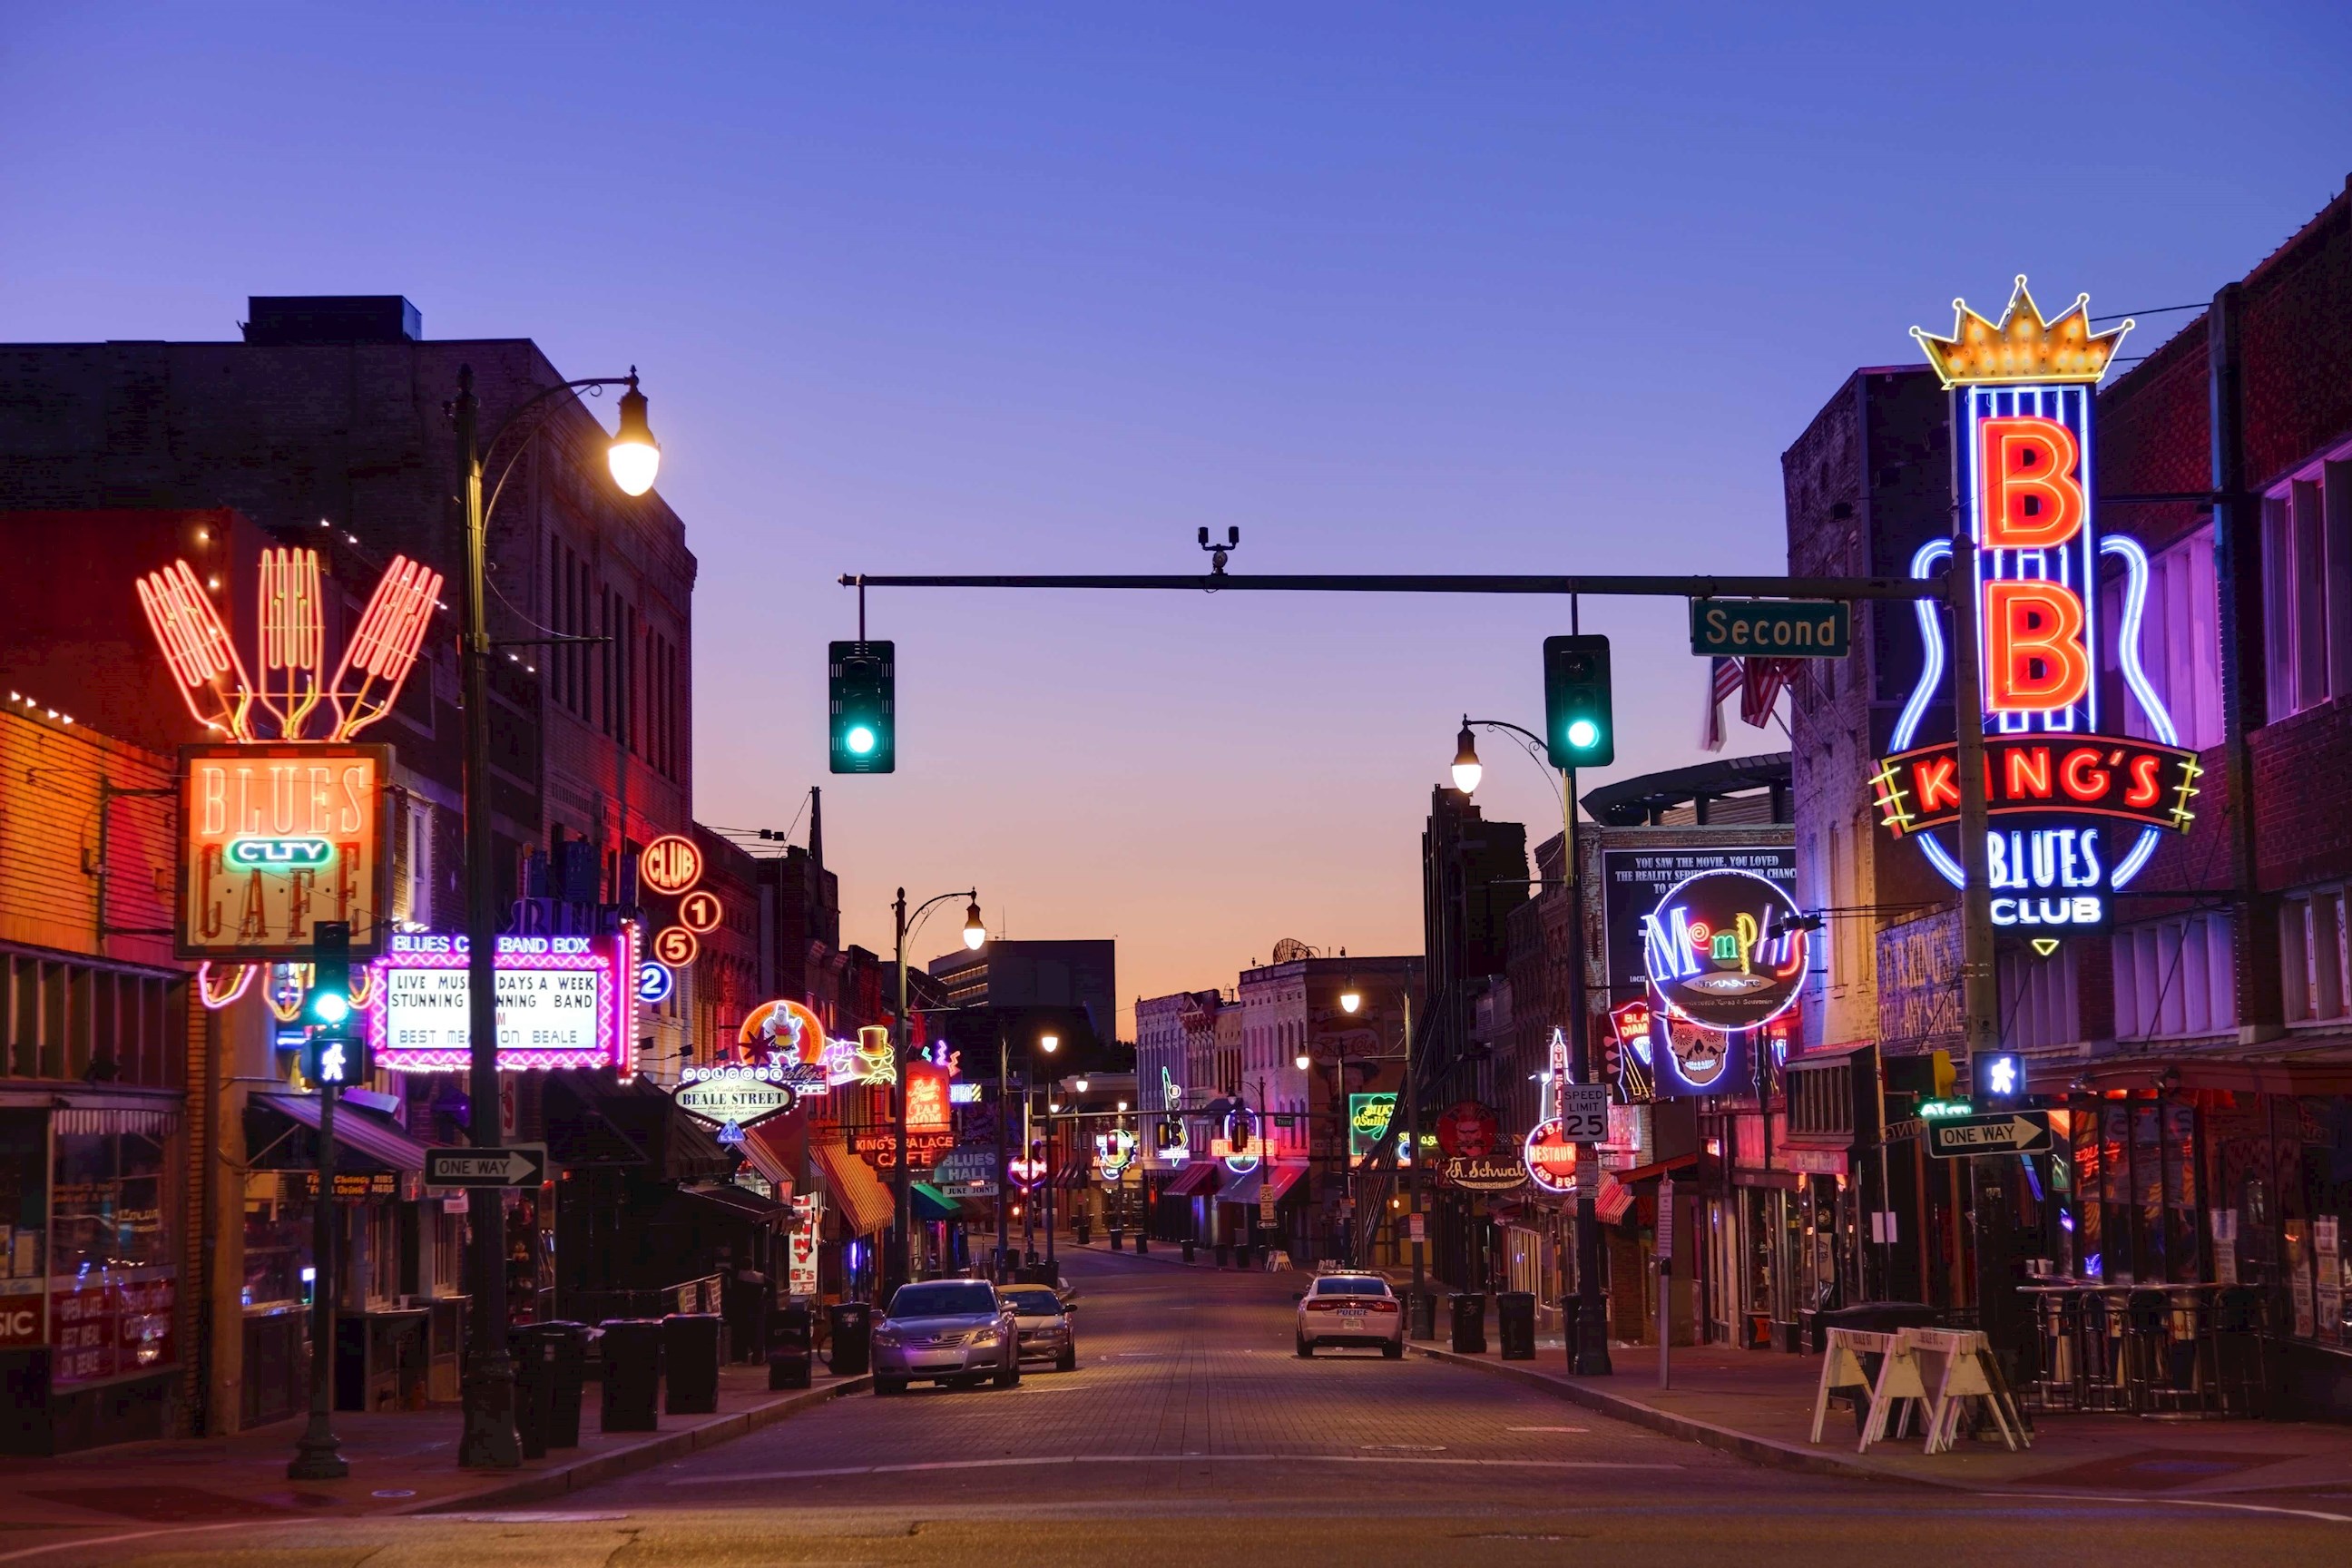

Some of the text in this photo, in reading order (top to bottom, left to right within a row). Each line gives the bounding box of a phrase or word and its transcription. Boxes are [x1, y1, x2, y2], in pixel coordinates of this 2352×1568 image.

[1978, 416, 2085, 550] B
[1706, 609, 1836, 647] Second
[1983, 578, 2090, 712] B
[201, 764, 365, 836] BLUES
[647, 841, 696, 887] CLUB
[1635, 855, 1779, 868] YOU SAW THE MOVIE, YOU LOVED
[1987, 828, 2100, 889] BLUES
[1615, 871, 1633, 881] THE
[1635, 870, 1671, 881] REALITY
[1653, 883, 1666, 895] TO
[691, 898, 708, 926] 1
[1989, 897, 2101, 923] CLUB
[392, 936, 451, 953] BLUES
[499, 937, 547, 954] BAND
[552, 937, 591, 954] BOX
[665, 933, 687, 960] 5
[397, 975, 426, 990] LIVE
[498, 976, 534, 990] DAYS
[539, 976, 548, 990] A
[558, 976, 595, 991] WEEK
[642, 967, 662, 995] 2
[391, 994, 465, 1008] STUNNING
[554, 995, 593, 1009] BAND
[1623, 1013, 1650, 1024] BLA
[399, 1030, 436, 1044] BEST
[533, 1030, 577, 1044] BEALE
[1620, 1024, 1648, 1037] DIAM
[682, 1067, 784, 1083] WELCOME
[795, 1083, 826, 1093] CAFE
[1564, 1090, 1603, 1101] SPEED
[683, 1092, 784, 1105] BEALE STREET
[915, 1103, 941, 1114] TAP
[1569, 1102, 1599, 1112] LIMIT
[1278, 1118, 1292, 1126] Third
[1567, 1114, 1604, 1136] 25
[1945, 1124, 2016, 1145] ONE WAY
[856, 1135, 897, 1151] KING'S
[942, 1152, 996, 1167] BLUES
[1530, 1145, 1577, 1162] RESTAUR
[1579, 1151, 1594, 1160] NO
[439, 1160, 510, 1174] ONE WAY
[948, 1167, 990, 1181] HALL
[1468, 1160, 1526, 1178] Schwab
[947, 1186, 995, 1195] JUKE JOINT
[1261, 1192, 1273, 1200] 25
